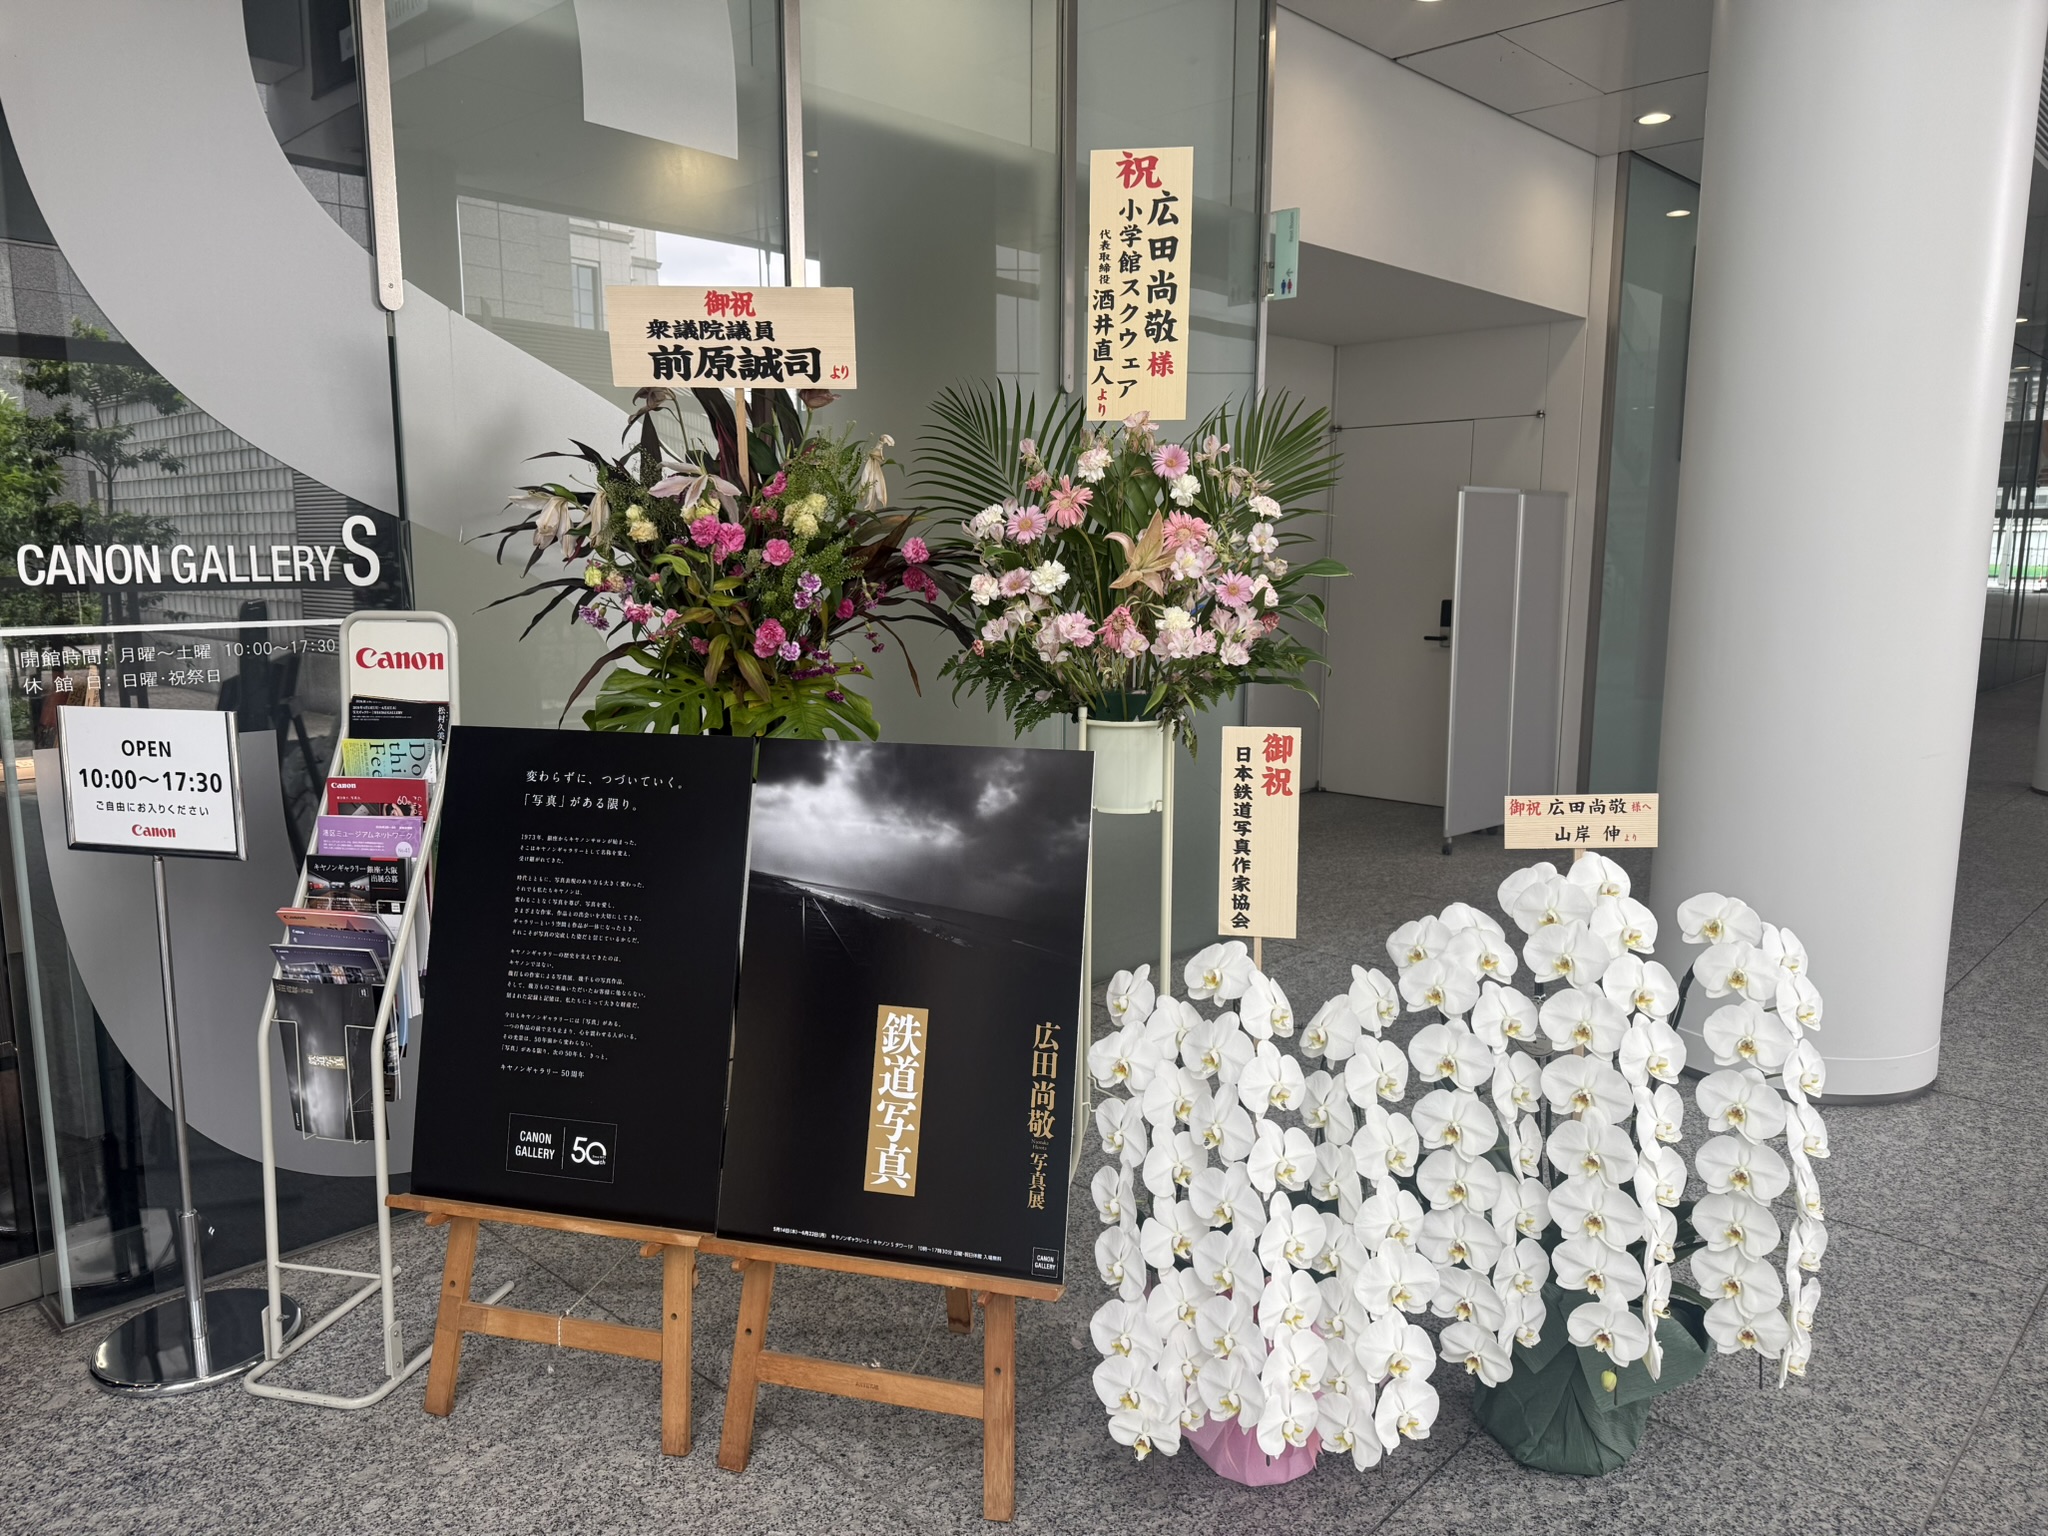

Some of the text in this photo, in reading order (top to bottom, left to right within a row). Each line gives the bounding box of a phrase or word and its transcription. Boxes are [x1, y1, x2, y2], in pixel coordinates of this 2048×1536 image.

[1116, 151, 1162, 189] 祝
[1144, 190, 1179, 378] 広田尚敬様
[704, 290, 756, 318] 御祝
[1118, 198, 1143, 399] 小学館スクウェア
[646, 318, 776, 342] 衆議院議員
[1092, 229, 1114, 417] 代表取締役 酒井直人より
[16, 515, 380, 588] CANON GALLERY S
[355, 647, 444, 670] Canon
[121, 740, 172, 758] OPEN
[1261, 733, 1294, 797] 御祝
[526, 770, 682, 790] 変わらずに、つづいていく。
[95, 800, 210, 817] ご自由にお入りください
[524, 793, 637, 811] 「写真」がある限り。
[1509, 799, 1542, 817] 御祝
[131, 824, 176, 838] Canon
[1231, 746, 1253, 929] 日本鉄道写真作家協会
[370, 874, 398, 883] 出展公募
[1027, 1022, 1062, 1140] 広田尚敬
[870, 1012, 922, 1189] 鉄道写真
[520, 1130, 552, 1144] CANON
[515, 1145, 555, 1160] GALLERY
[1027, 1152, 1048, 1210] 写真展
[1034, 1262, 1056, 1271] GALLERY
[1036, 1254, 1054, 1262] CANON
